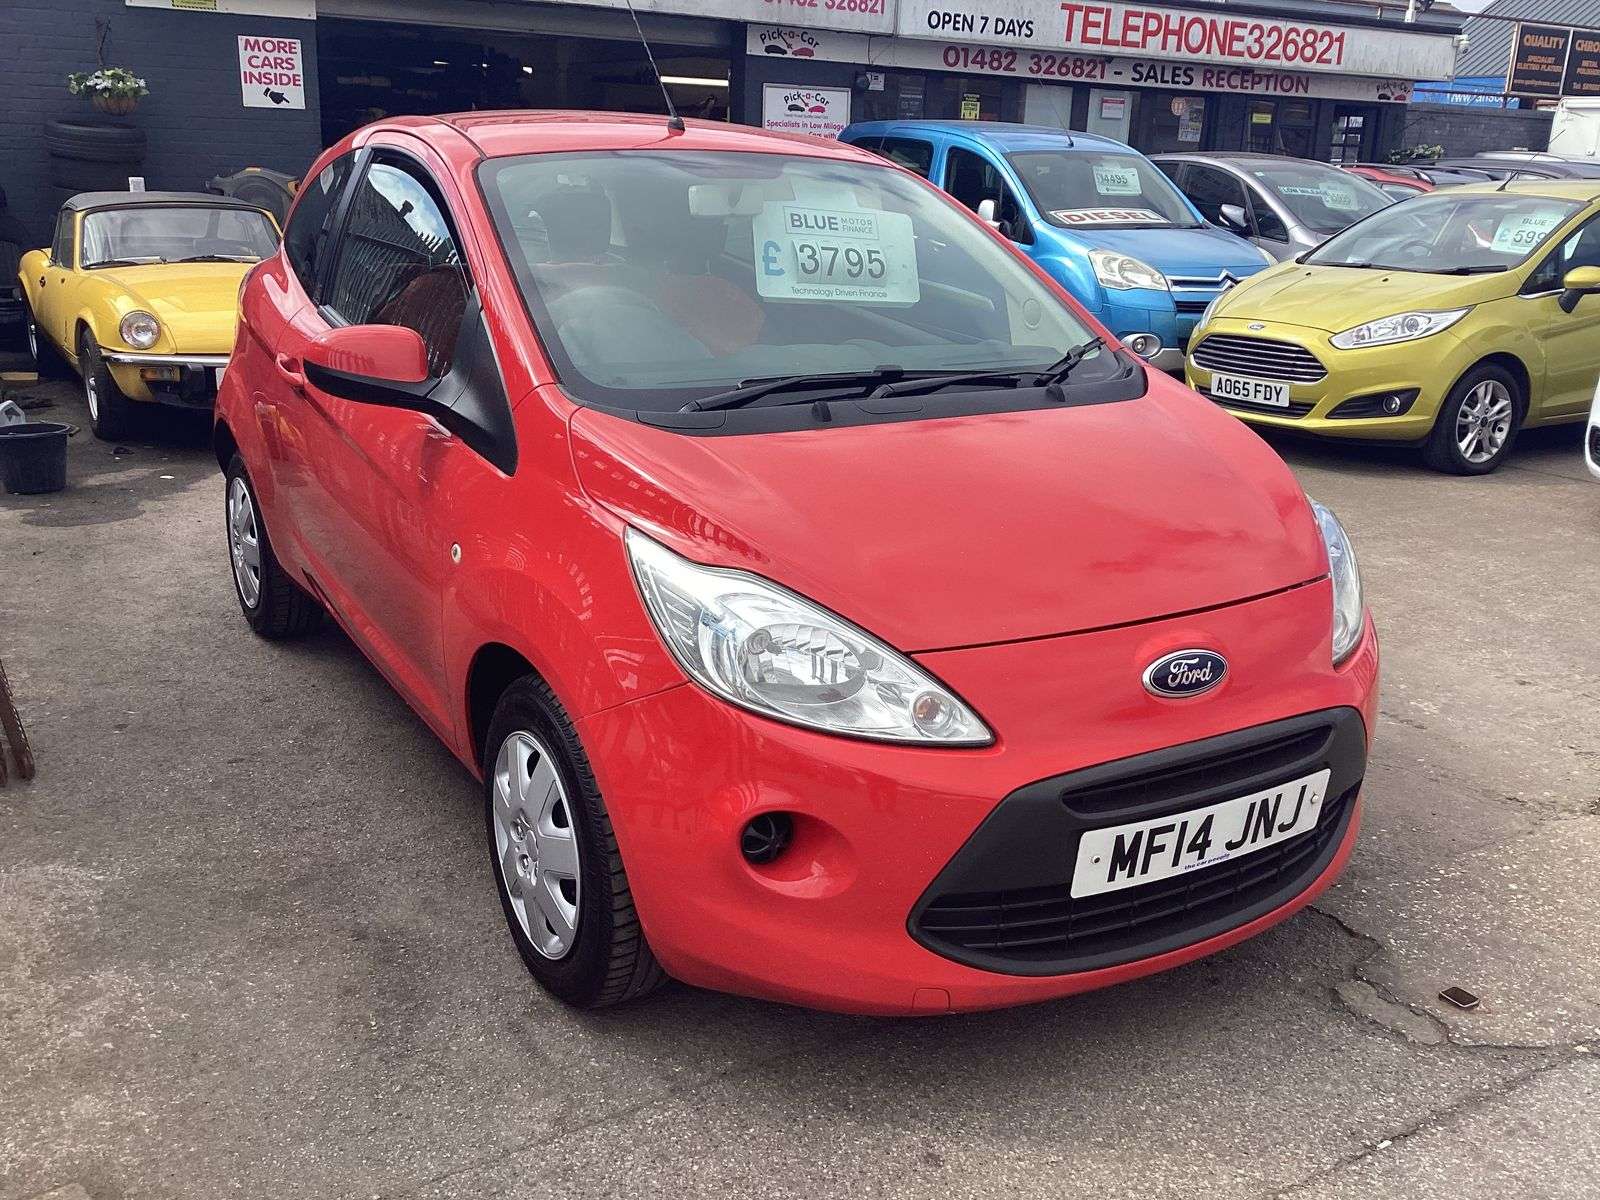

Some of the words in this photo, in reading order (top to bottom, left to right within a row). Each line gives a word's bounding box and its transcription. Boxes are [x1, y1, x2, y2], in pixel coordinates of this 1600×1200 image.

[927, 10, 974, 33] OPEN
[980, 16, 990, 34] 7
[994, 18, 1034, 38] DAYS
[244, 38, 298, 54] MORE
[1523, 34, 1565, 49] QUALITY
[247, 54, 296, 71] CARS
[943, 46, 1018, 72] 01482
[1029, 54, 1107, 79] 326821
[1131, 62, 1194, 86] SALES
[1202, 68, 1310, 94] RECEPTION
[242, 71, 302, 87] INSIDE
[783, 92, 830, 106] Pick-a-Car
[766, 120, 800, 129] Specialists
[823, 122, 844, 131] Milage
[790, 213, 839, 231] BLUE
[841, 217, 873, 226] MOTOR
[1062, 211, 1163, 222] DIESEL
[1522, 218, 1547, 226] BLUE
[842, 225, 873, 234] FINANCE
[762, 240, 785, 276] £
[799, 243, 886, 279] 3795
[791, 286, 834, 297] Technology
[835, 288, 858, 297] Driven
[859, 289, 888, 298] Finance
[1253, 383, 1283, 402] FDY
[1167, 657, 1213, 688] Ford
[1106, 813, 1215, 883] MF14
[1224, 784, 1308, 851] JNJ
